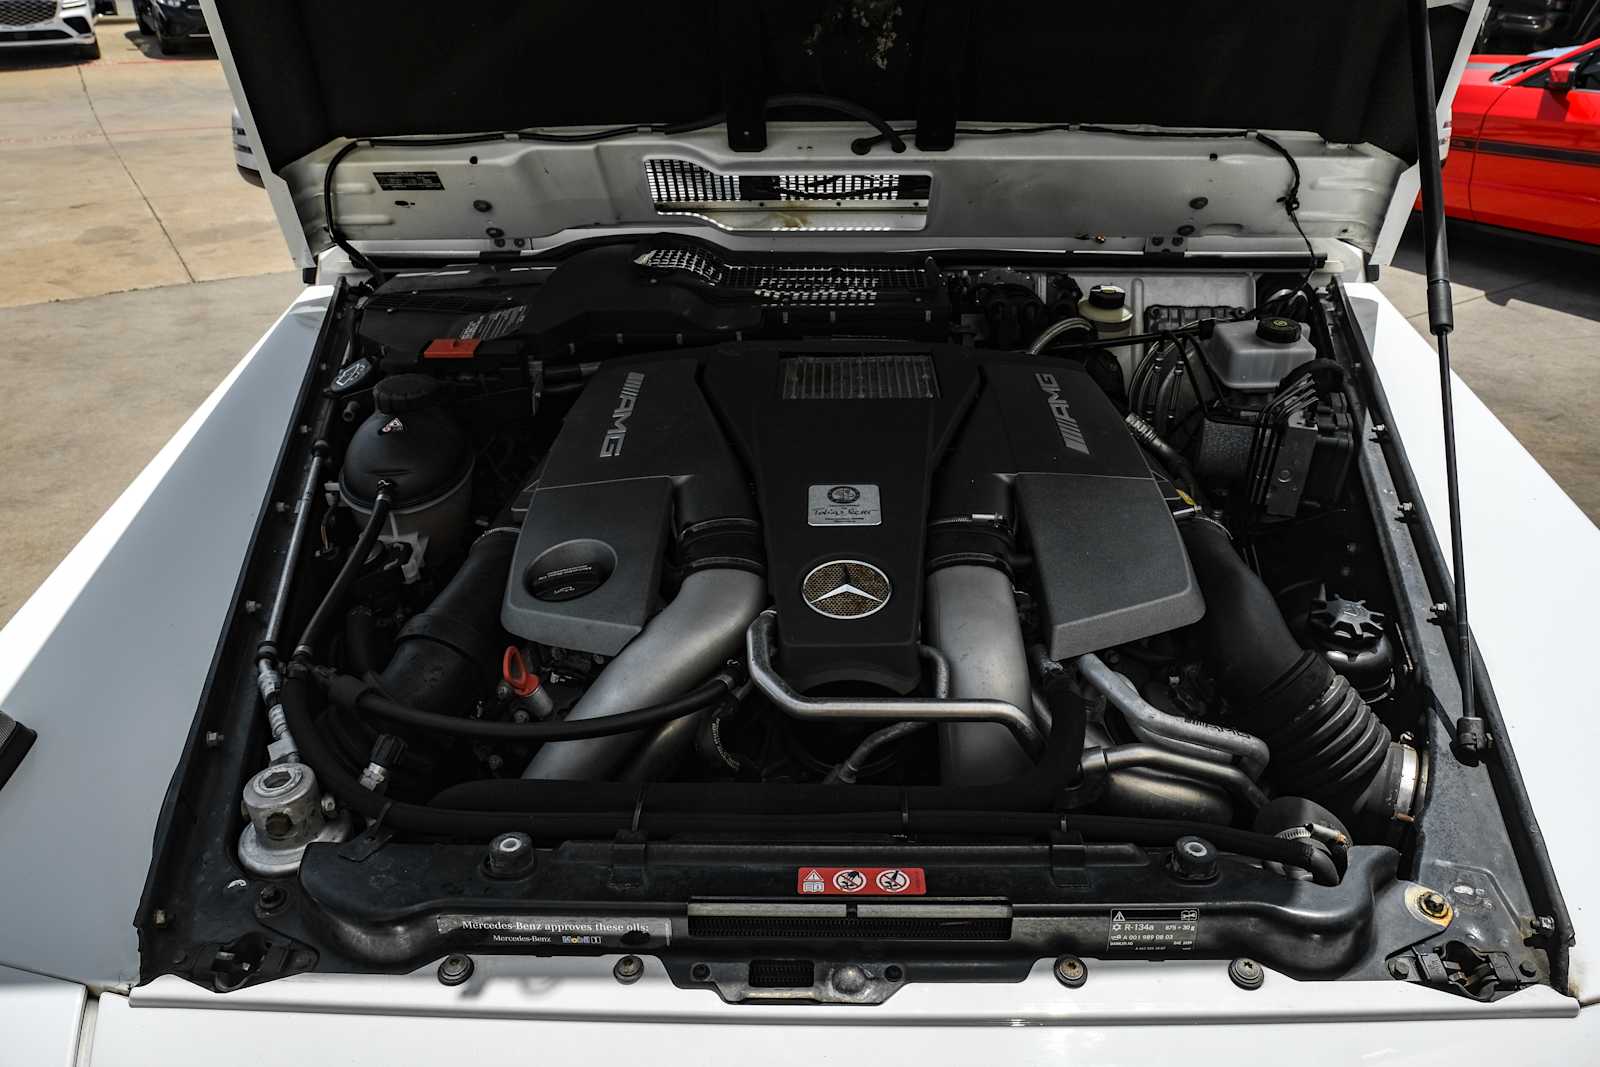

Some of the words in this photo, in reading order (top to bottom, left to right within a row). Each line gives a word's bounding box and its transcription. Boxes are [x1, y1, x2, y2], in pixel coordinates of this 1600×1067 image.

[1036, 373, 1081, 434] AMG
[600, 388, 641, 457] AMG
[462, 920, 542, 931] Mercedes-Benz
[545, 923, 592, 934] approves
[595, 922, 624, 932] these
[1124, 923, 1154, 931] R-134a
[493, 934, 551, 943] Mercedes-Benz
[562, 935, 590, 944] Mobil
